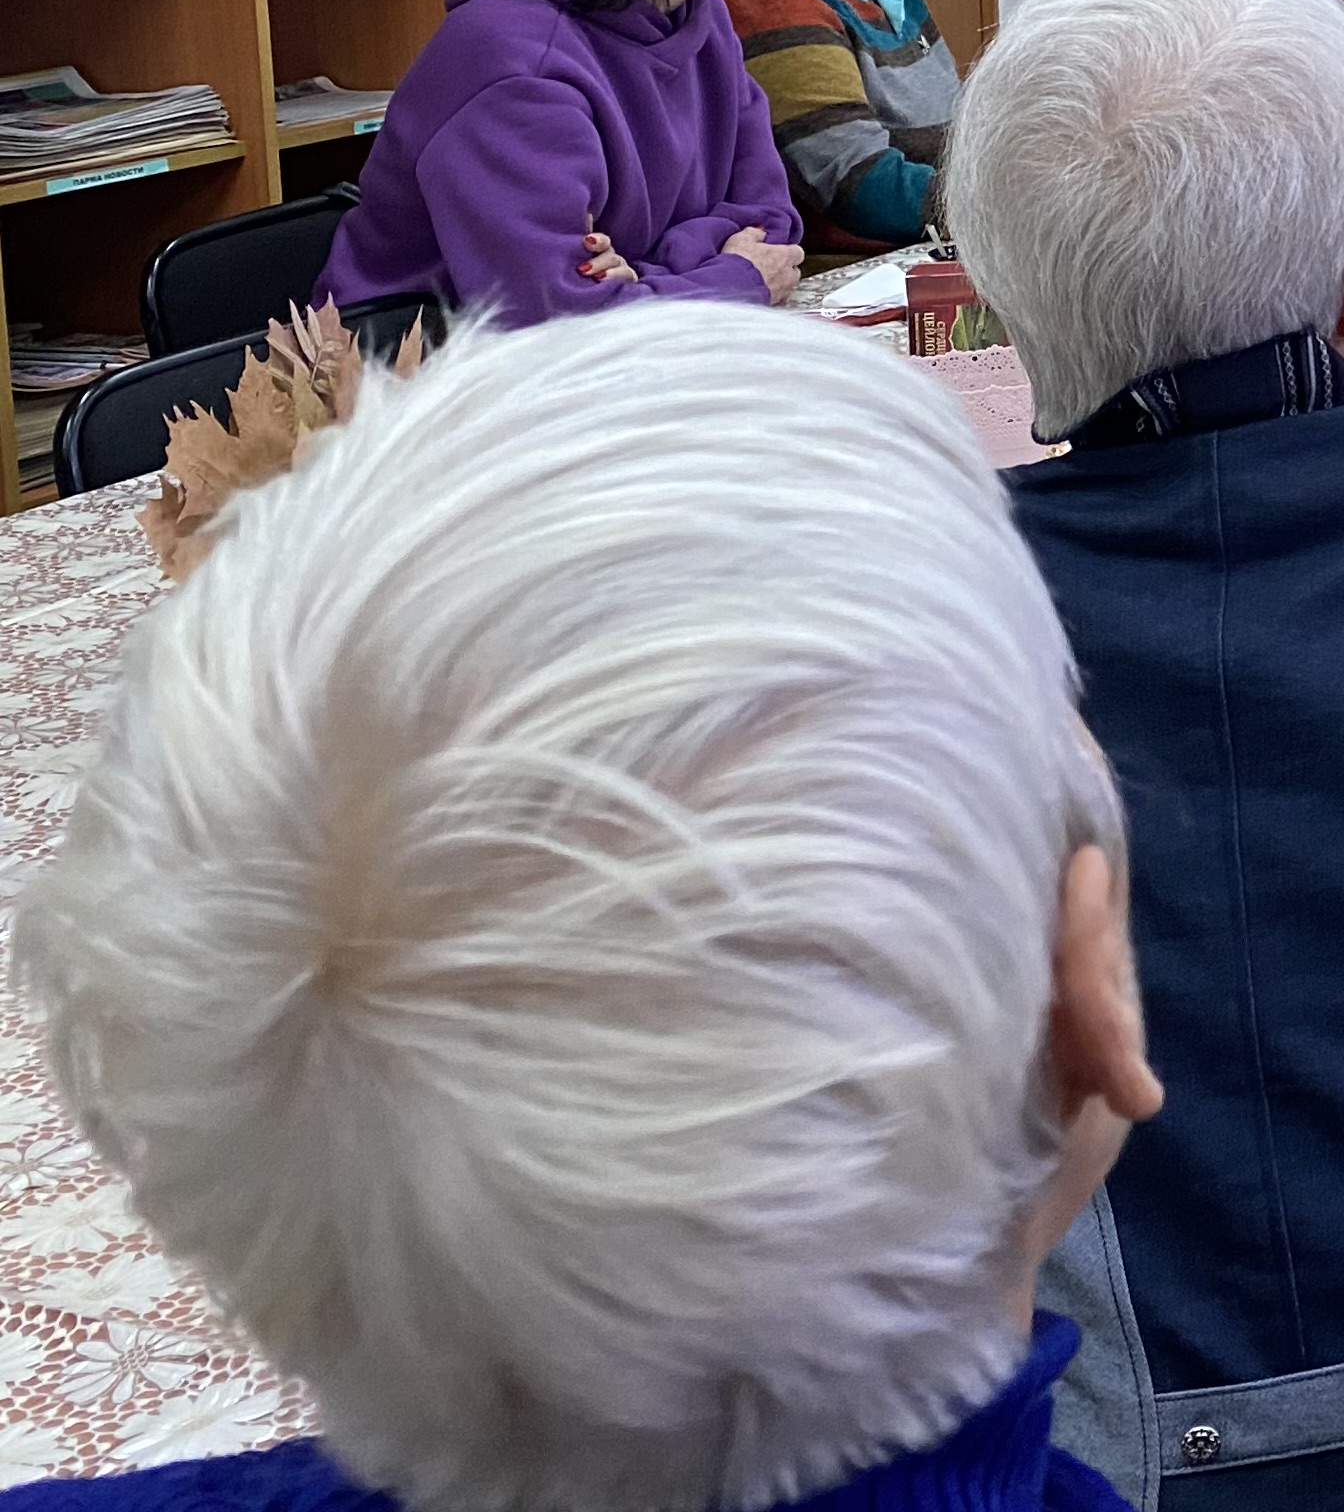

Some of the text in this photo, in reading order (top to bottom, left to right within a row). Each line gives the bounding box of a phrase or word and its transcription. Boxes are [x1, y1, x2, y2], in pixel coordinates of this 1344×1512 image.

[73, 167, 144, 186] ПАРМА НОВОСТИ
[937, 321, 947, 356] СЕРДЦ
